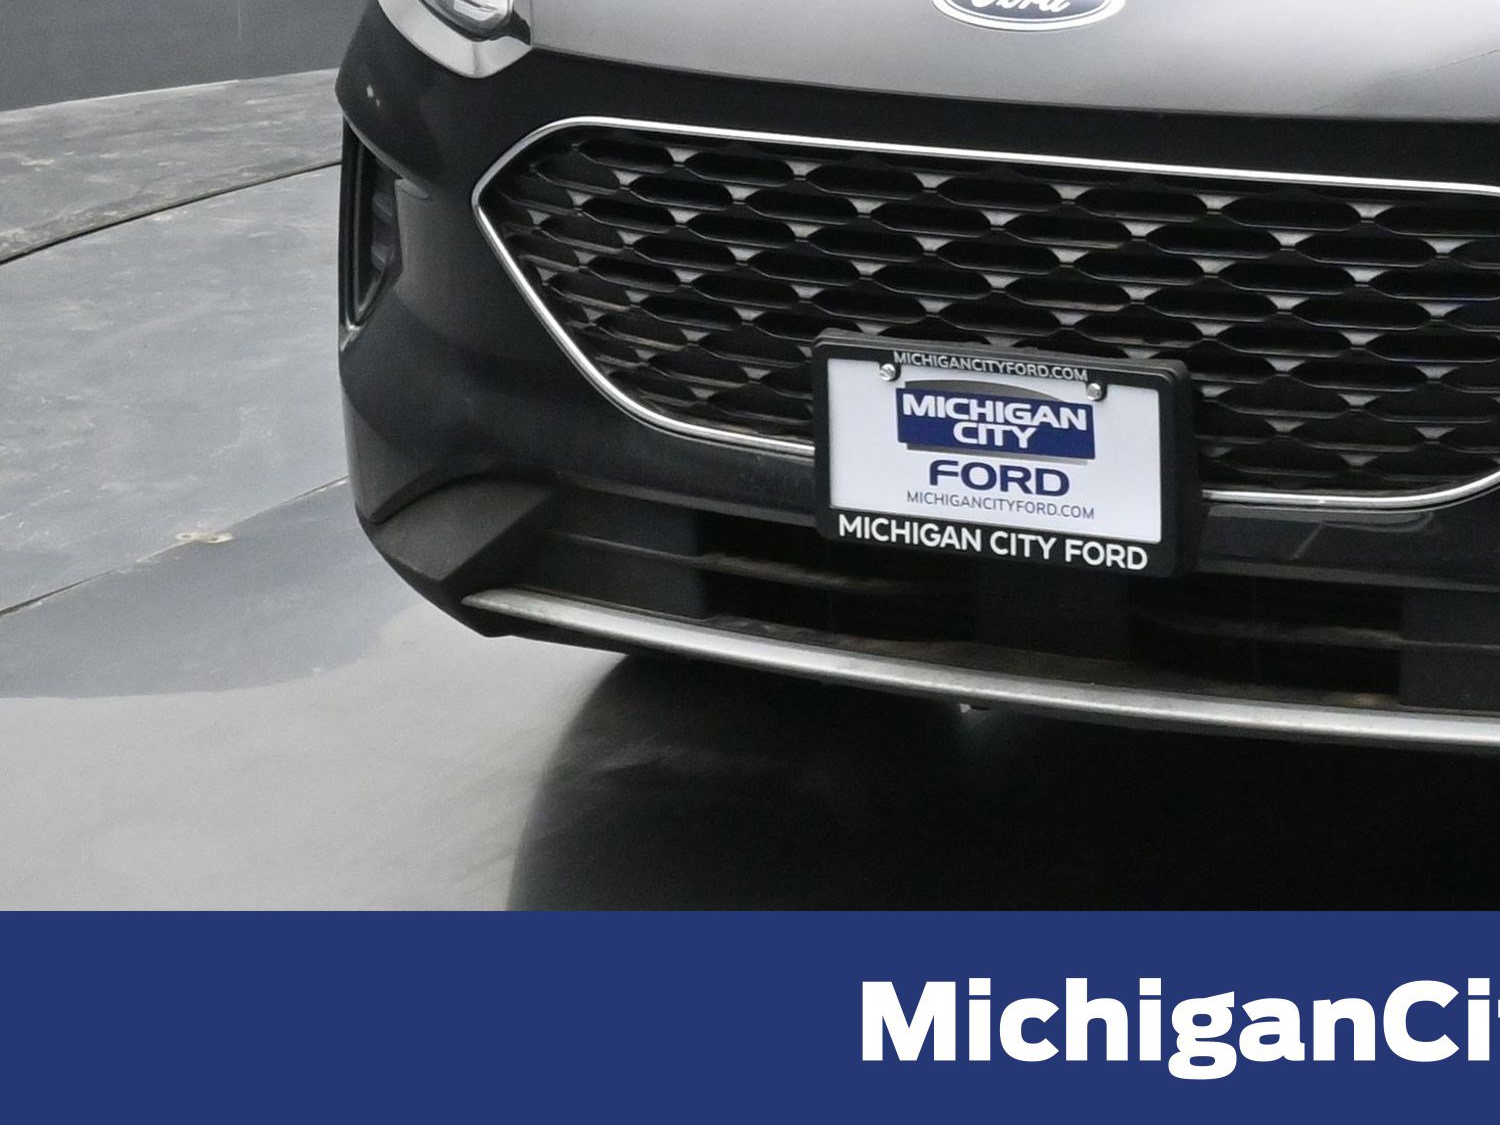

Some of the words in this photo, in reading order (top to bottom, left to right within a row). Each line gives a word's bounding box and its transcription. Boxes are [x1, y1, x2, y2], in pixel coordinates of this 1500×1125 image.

[893, 351, 1088, 382] MICHIGANCITYFORD.COM
[902, 393, 1087, 431] MICHIGAN
[953, 422, 1037, 449] CITY
[929, 459, 1070, 497] FORD
[906, 490, 1095, 520] MICHIGANCITYFORD.COM
[838, 514, 982, 552] MICHIGAN
[989, 531, 1057, 560] CITY
[1064, 539, 1149, 571] FORD
